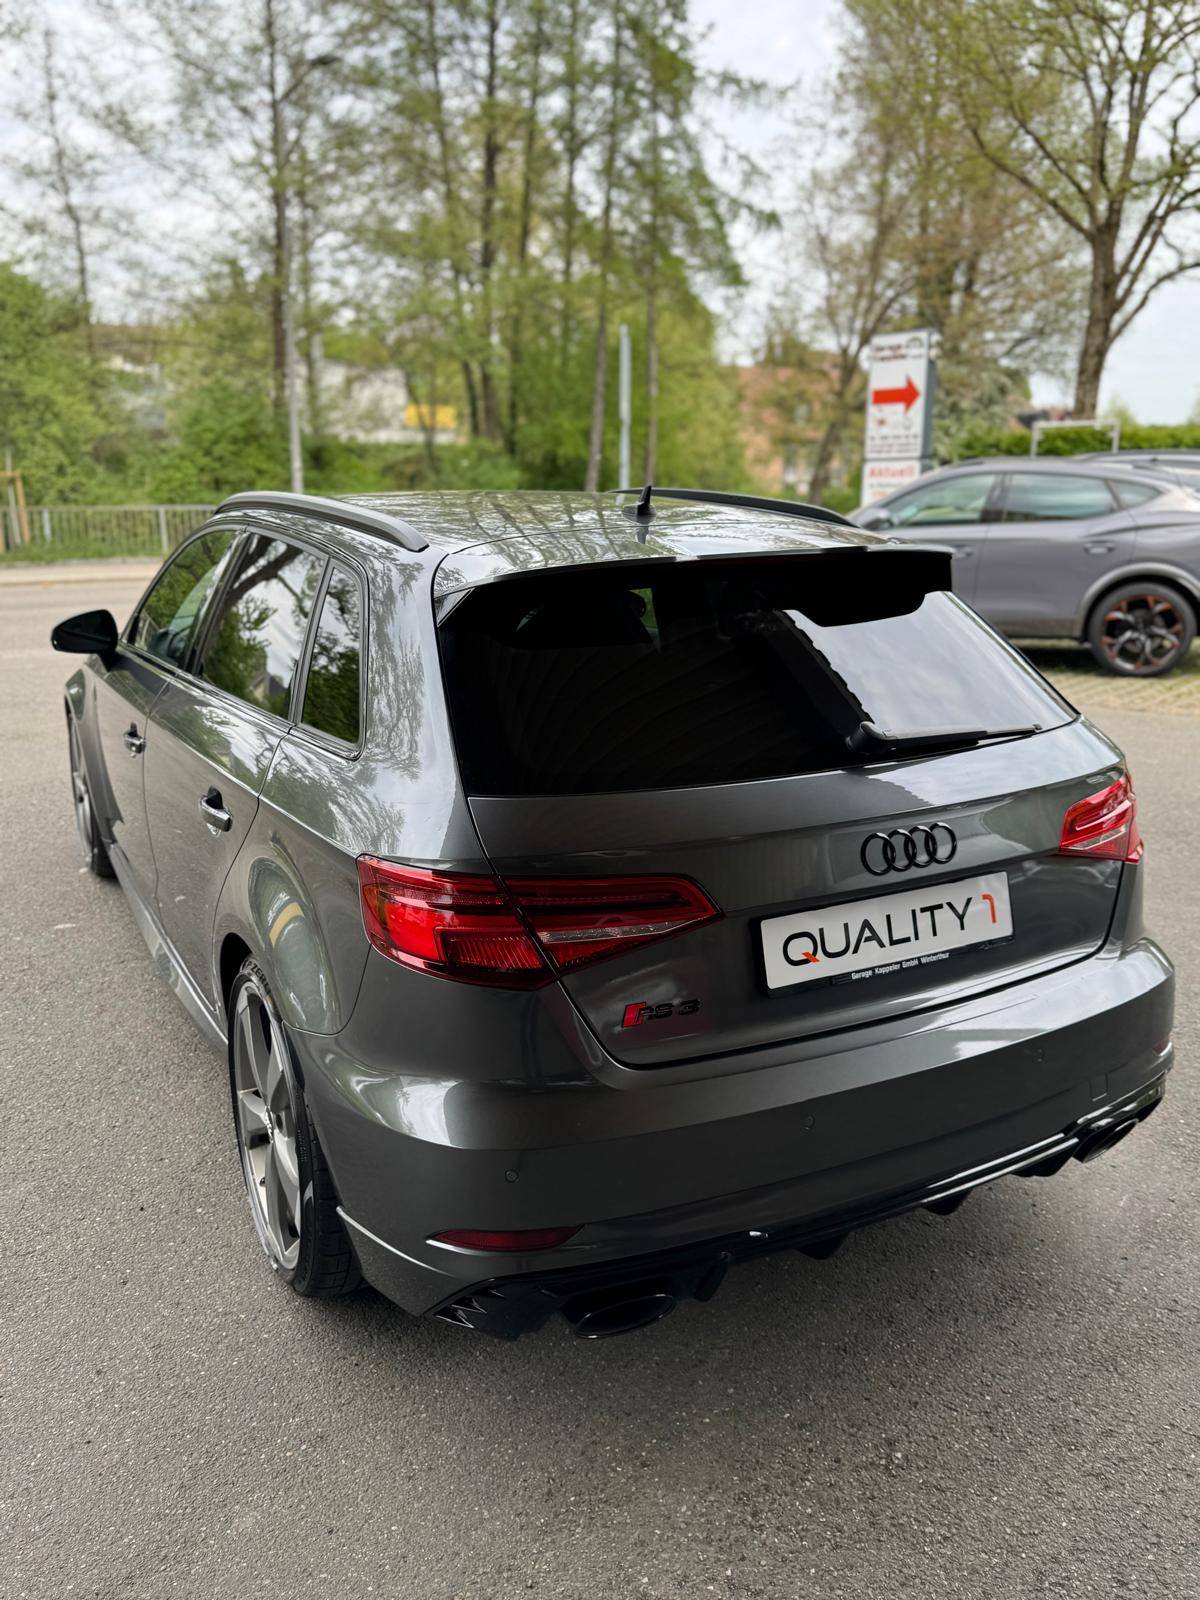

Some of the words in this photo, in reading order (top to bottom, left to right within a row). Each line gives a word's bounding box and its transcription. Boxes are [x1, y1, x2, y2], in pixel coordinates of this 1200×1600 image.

[851, 969, 873, 980] Garage
[875, 963, 901, 974] Kappeler
[902, 958, 919, 969] GmbH
[920, 952, 950, 964] Winterthur
